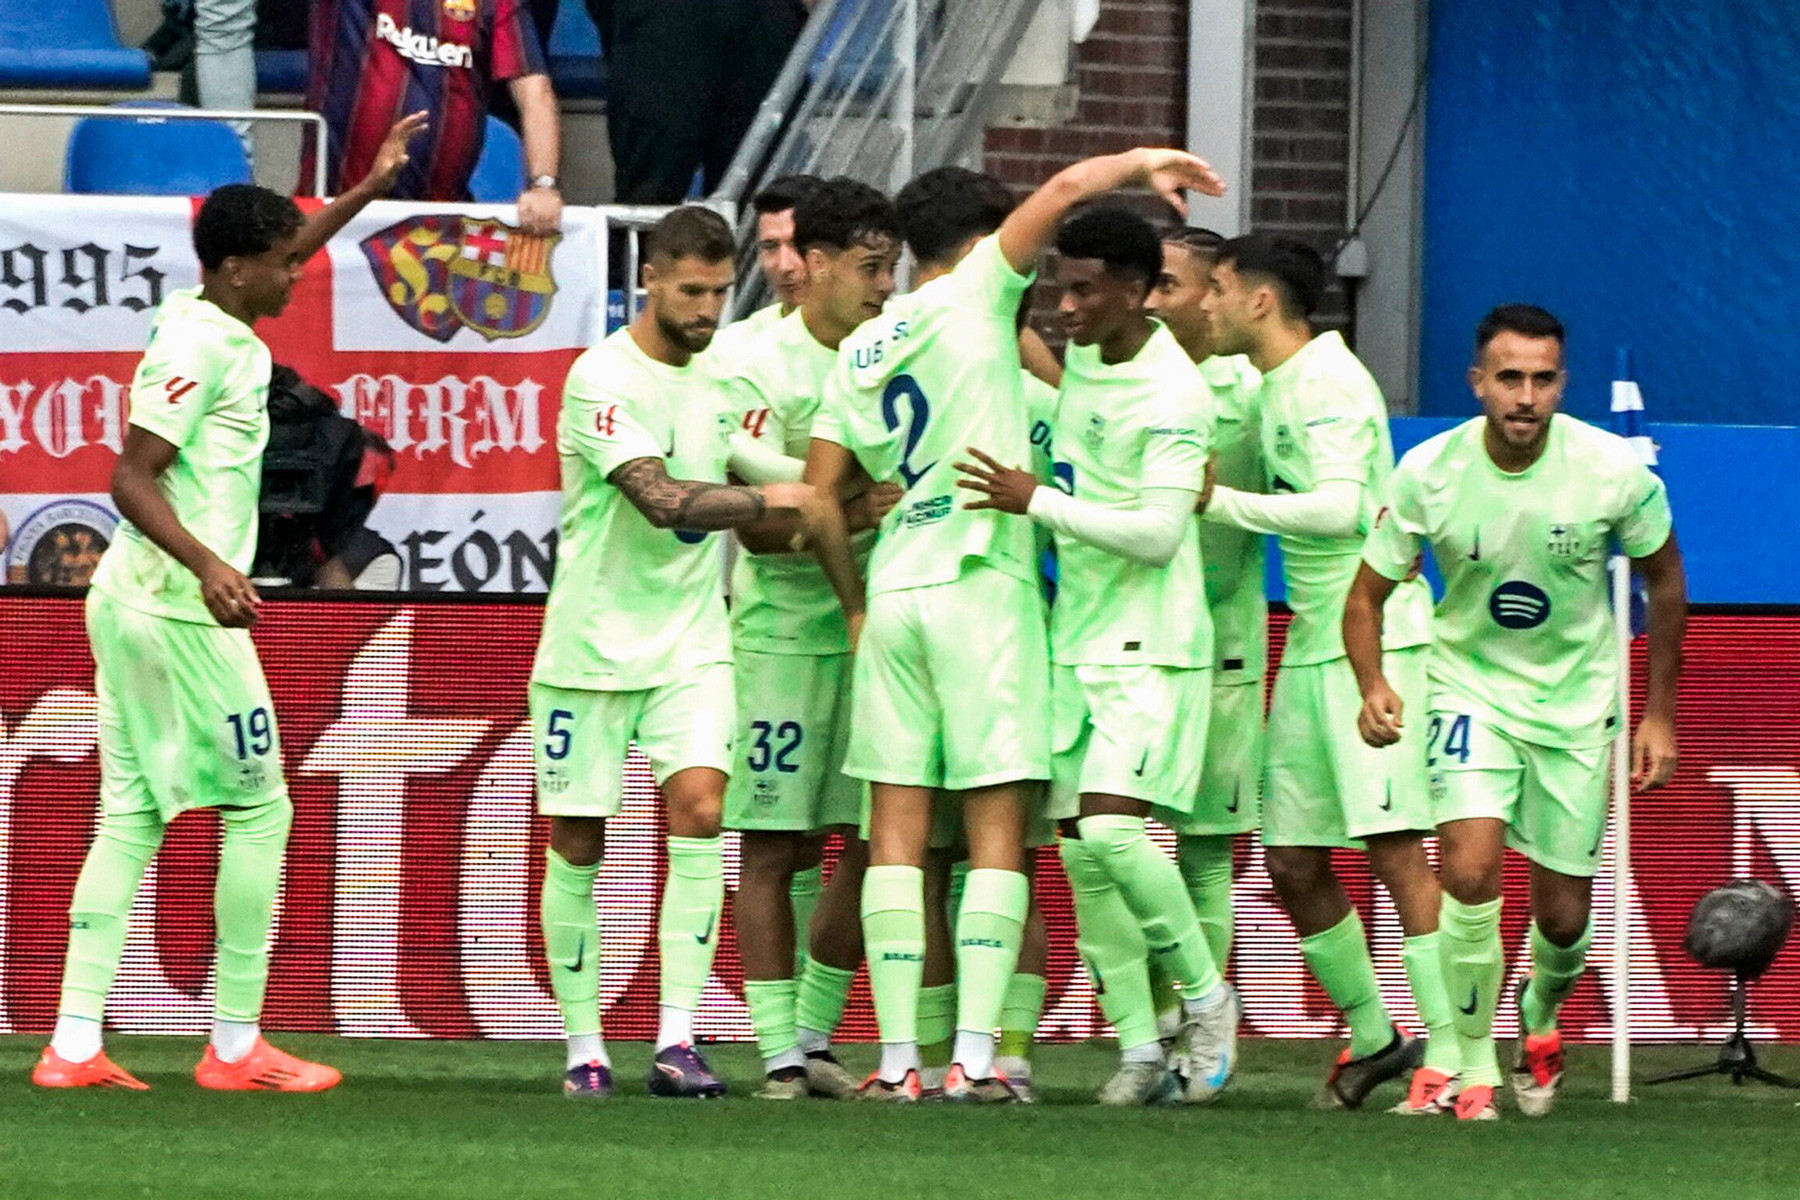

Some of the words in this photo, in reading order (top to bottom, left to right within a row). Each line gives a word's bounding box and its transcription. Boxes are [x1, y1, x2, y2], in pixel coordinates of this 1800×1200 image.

[376, 12, 473, 69] Rakuen
[882, 373, 941, 490] 2
[225, 707, 272, 760] 19
[545, 709, 574, 760] 5
[747, 721, 803, 772] 32
[1425, 713, 1471, 767] 24
